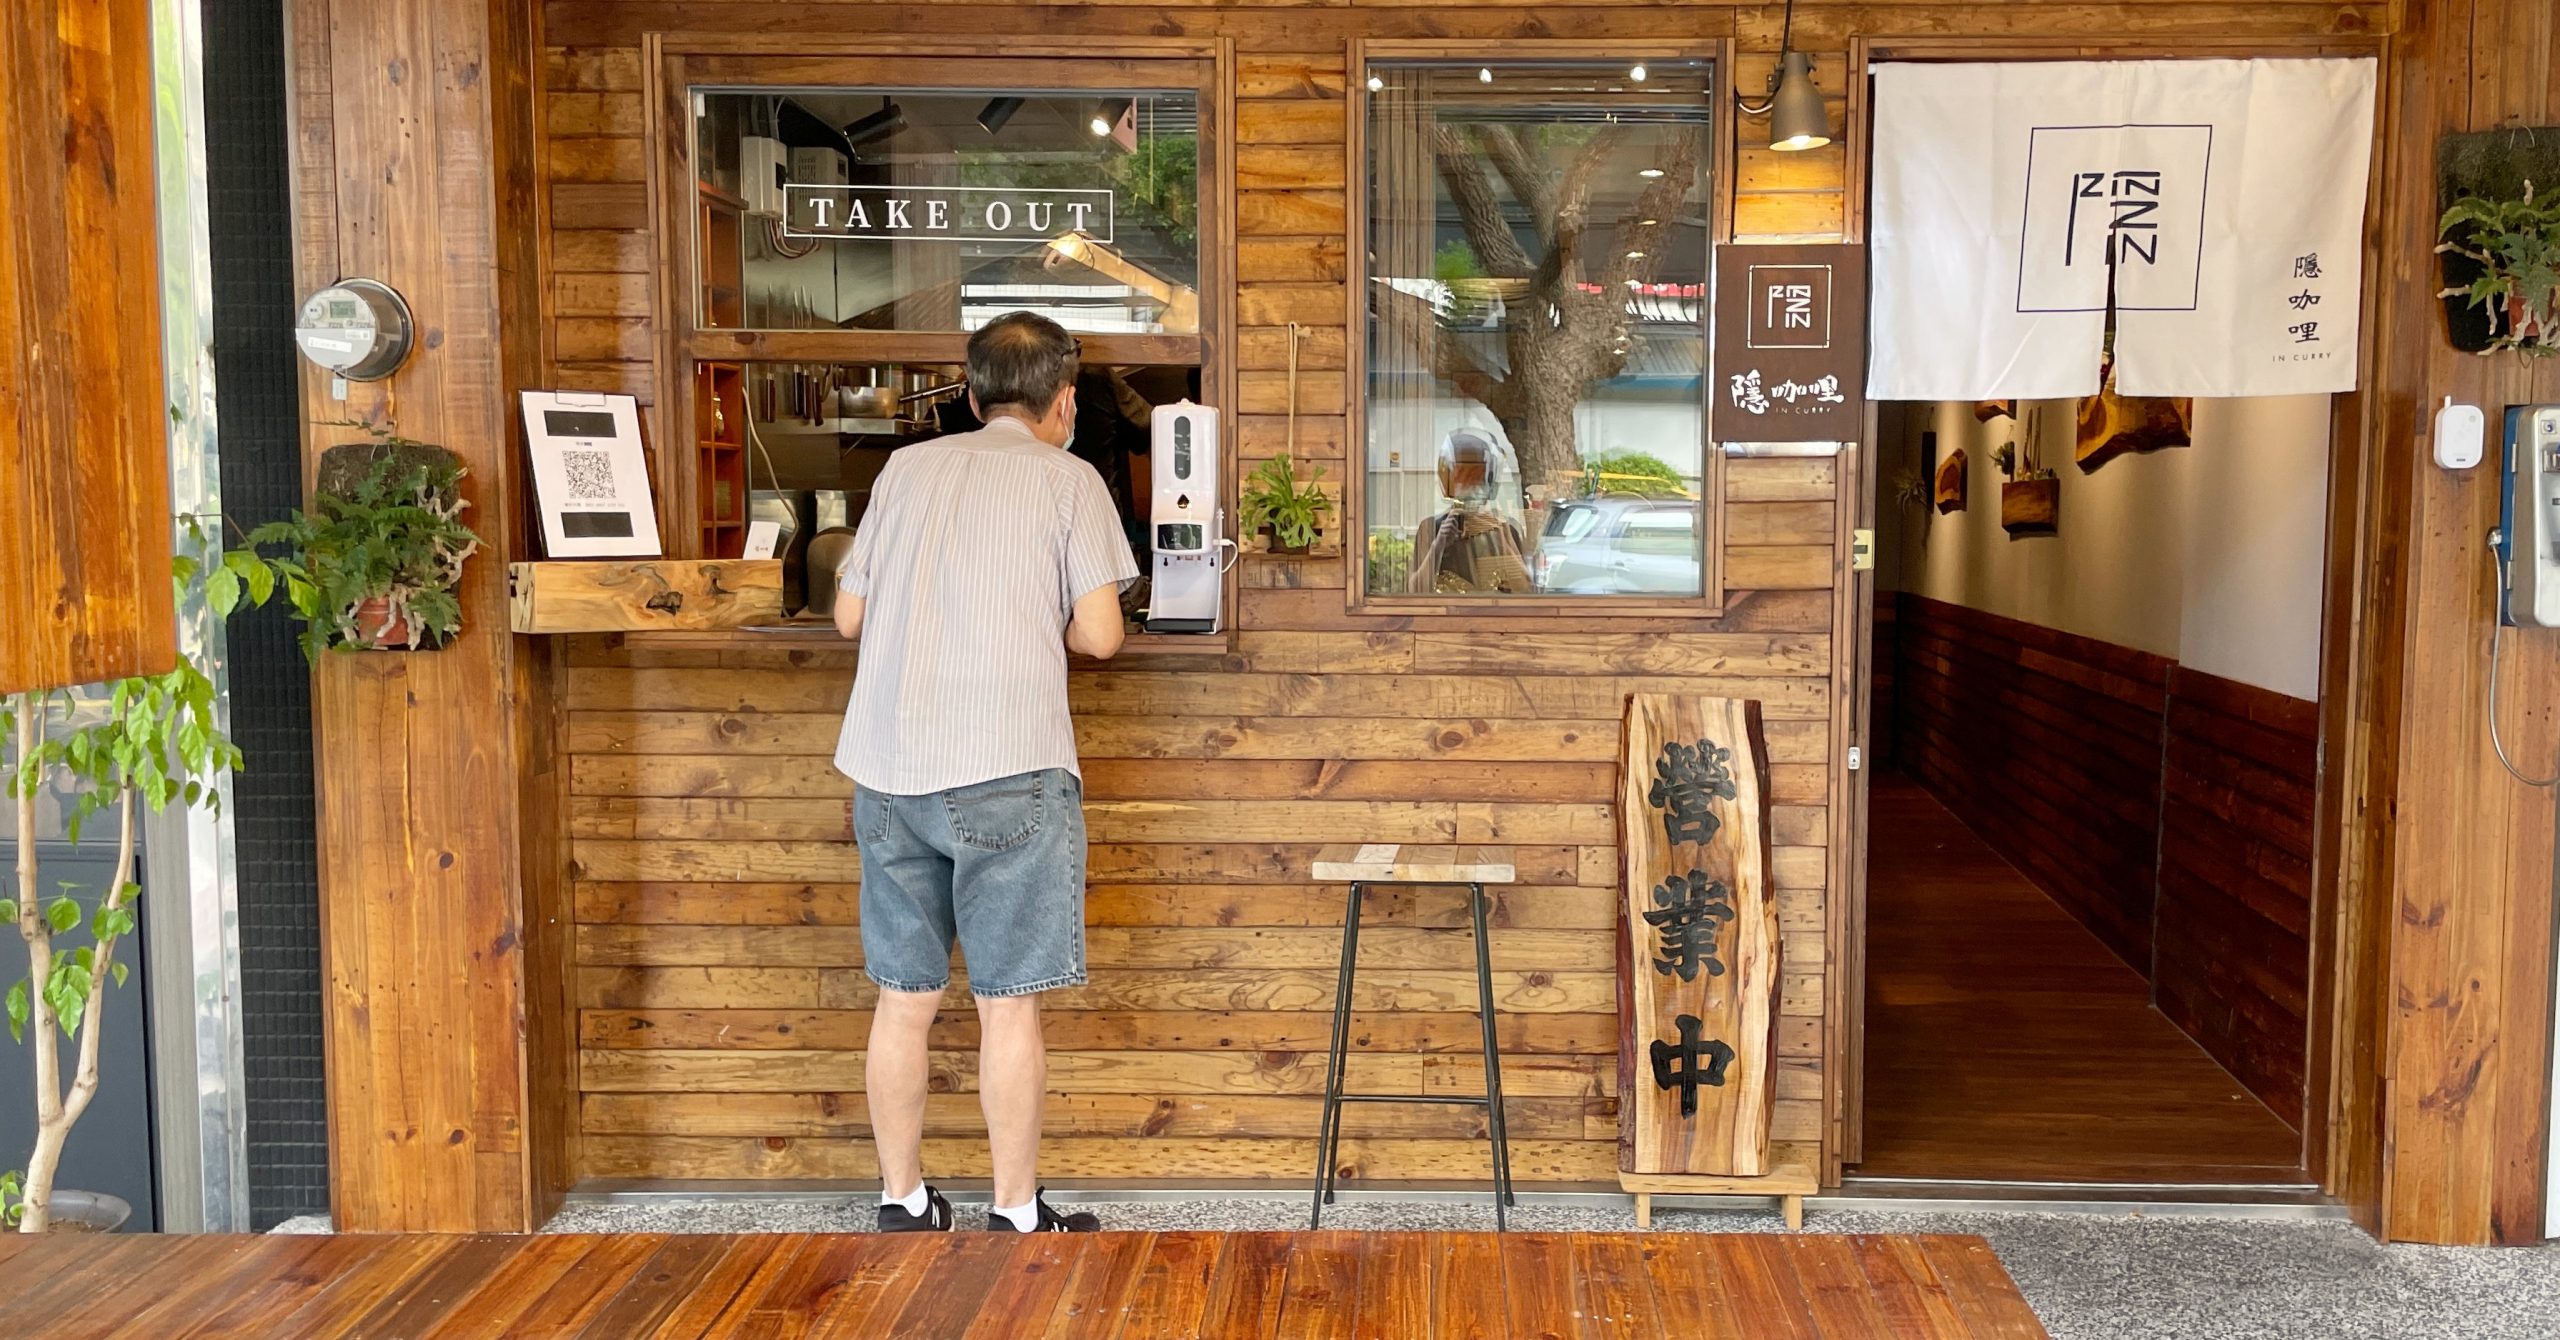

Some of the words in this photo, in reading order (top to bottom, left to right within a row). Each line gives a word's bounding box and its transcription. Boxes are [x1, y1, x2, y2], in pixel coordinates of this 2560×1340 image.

[809, 197, 949, 230] TAKE
[985, 200, 1092, 232] OUT
[2288, 252, 2323, 344] 隱咖哩
[2272, 354, 2286, 363] IN
[2293, 352, 2332, 363] CURRY
[1730, 368, 1845, 415] 隱咖哩
[1643, 738, 1736, 1120] 營業中
